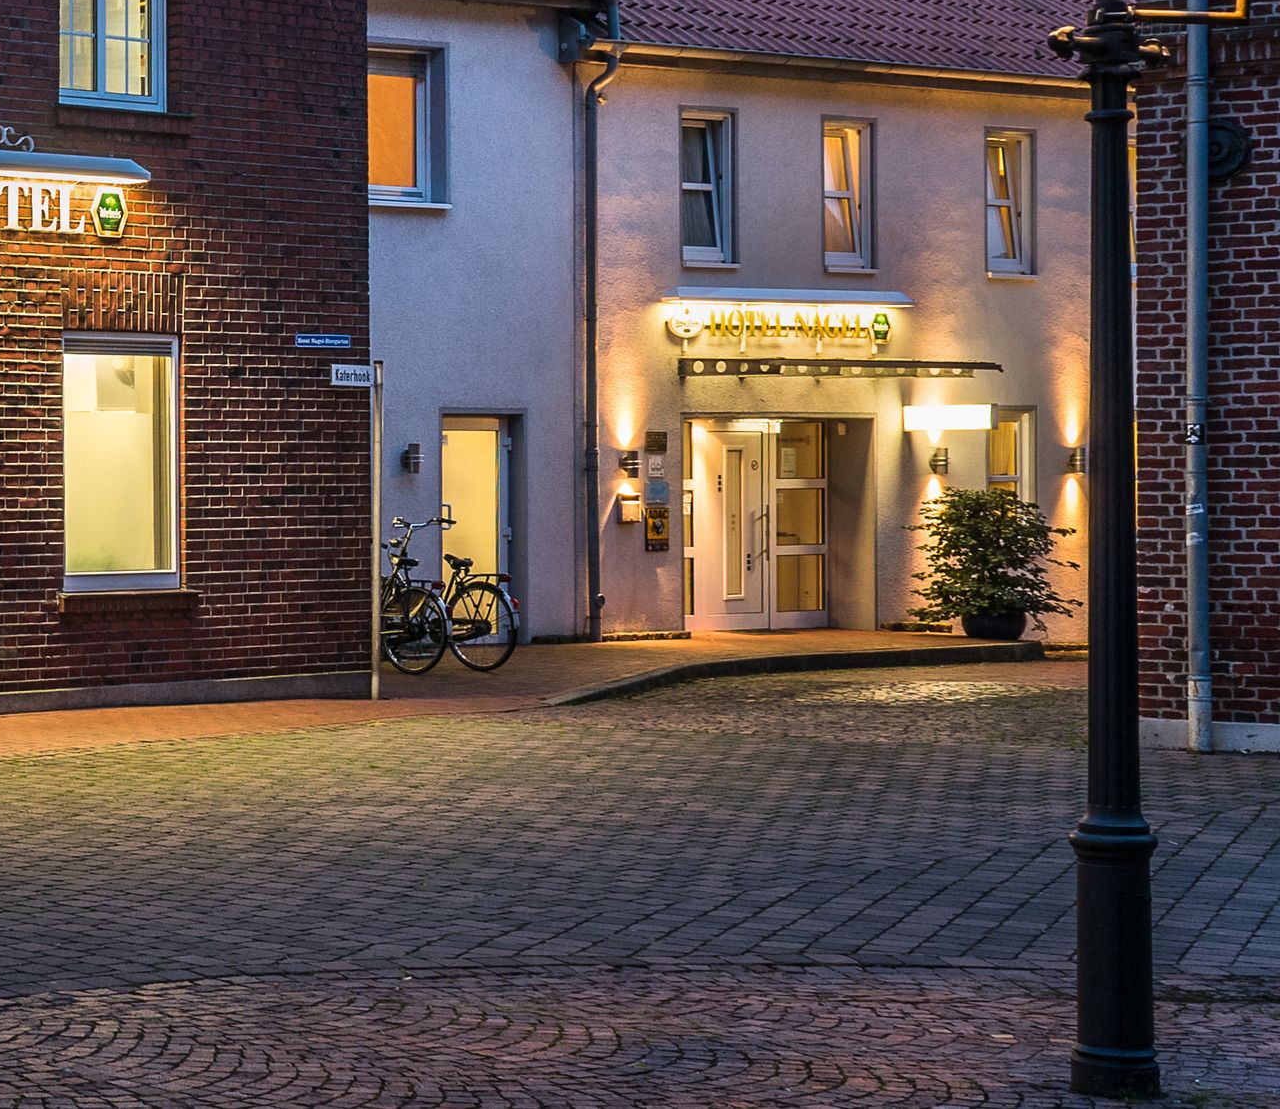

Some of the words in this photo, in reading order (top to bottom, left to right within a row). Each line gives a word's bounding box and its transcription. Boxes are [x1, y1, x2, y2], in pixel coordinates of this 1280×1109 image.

[710, 309, 789, 338] HOTEL
[794, 311, 869, 339] NAGEL
[335, 369, 370, 383] Katerhook
